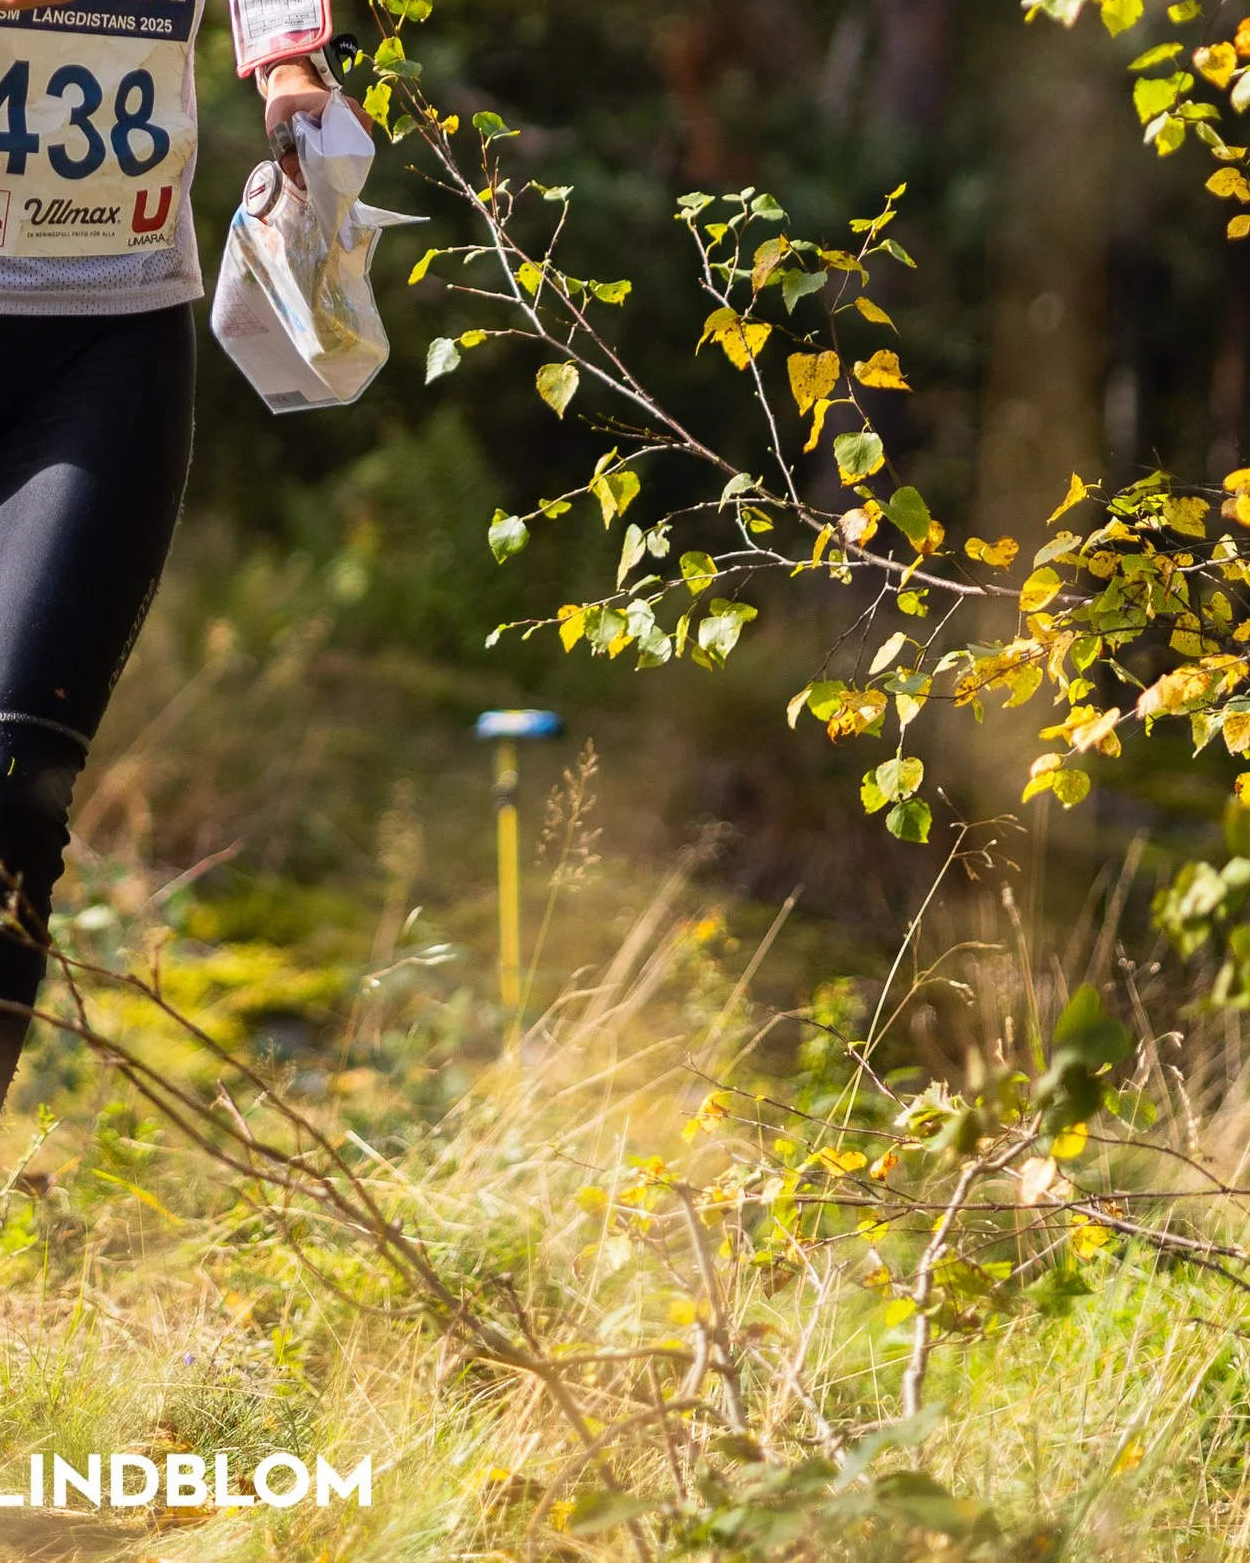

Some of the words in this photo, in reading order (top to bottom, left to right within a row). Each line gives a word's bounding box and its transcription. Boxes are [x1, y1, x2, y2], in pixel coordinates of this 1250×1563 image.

[32, 7, 136, 30] LÅNGDISTANS
[140, 16, 173, 34] 2025
[24, 198, 121, 226] Ullmax
[128, 233, 166, 247] UMARA
